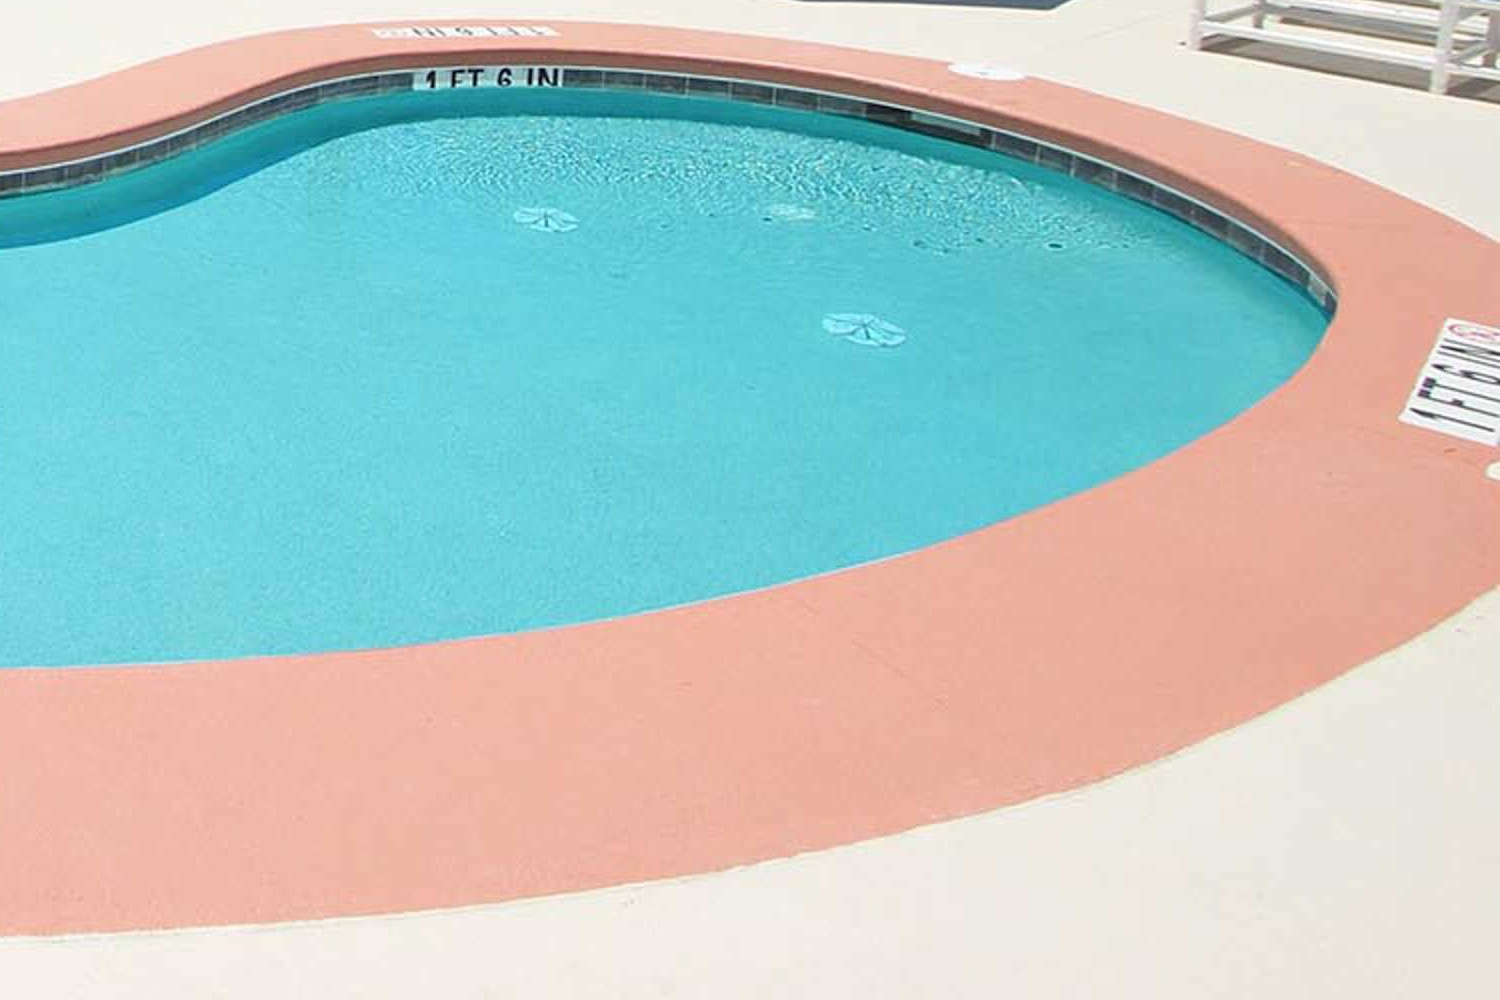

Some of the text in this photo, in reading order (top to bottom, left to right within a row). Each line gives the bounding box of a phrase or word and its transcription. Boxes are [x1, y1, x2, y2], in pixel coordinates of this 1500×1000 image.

[425, 67, 559, 89] 1 FT 6 IN
[1416, 375, 1500, 418] FT
[1409, 407, 1496, 432] 1
